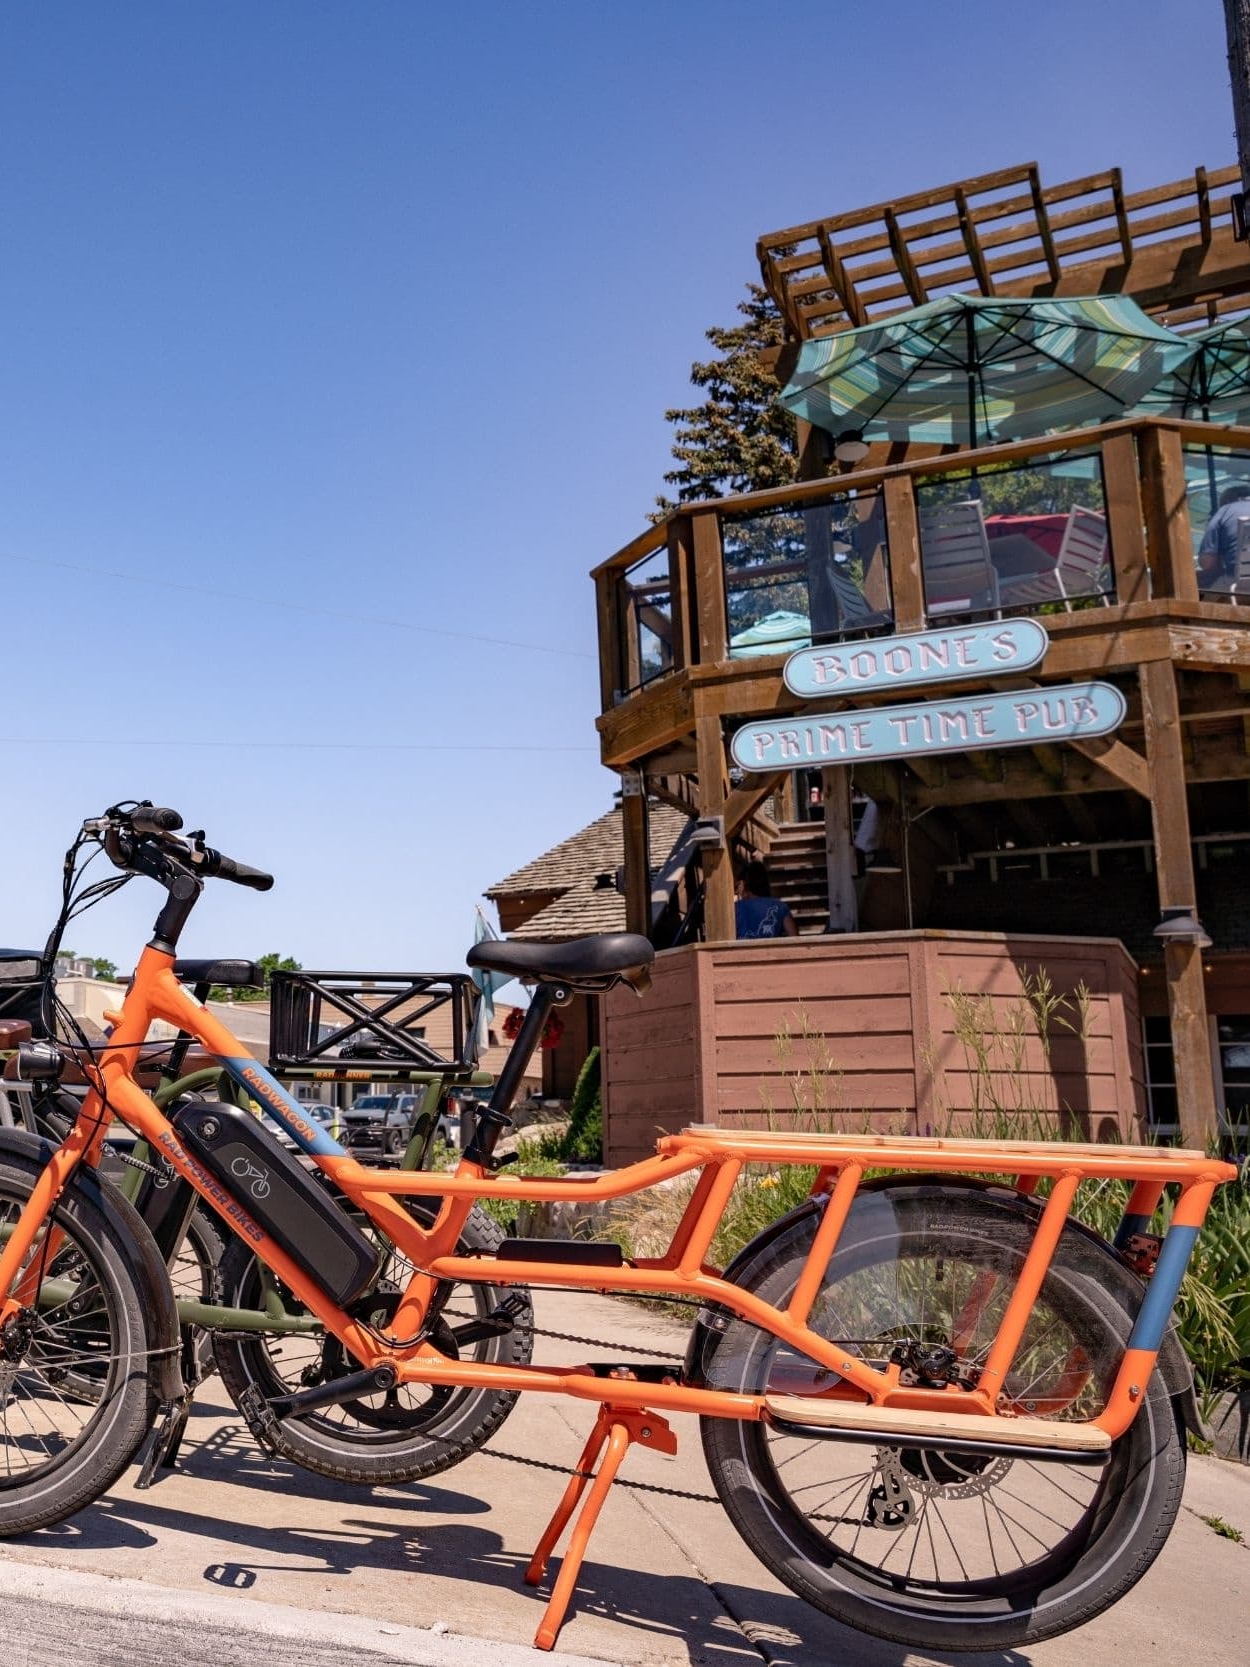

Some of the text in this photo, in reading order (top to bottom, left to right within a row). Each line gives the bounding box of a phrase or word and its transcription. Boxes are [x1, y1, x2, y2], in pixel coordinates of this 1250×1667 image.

[811, 631, 1018, 686] BOONE'S
[752, 696, 1099, 761] PRIME TIME PUB
[241, 1066, 317, 1142] RADWAGON
[158, 1131, 264, 1242] RAD POWER BIKES
